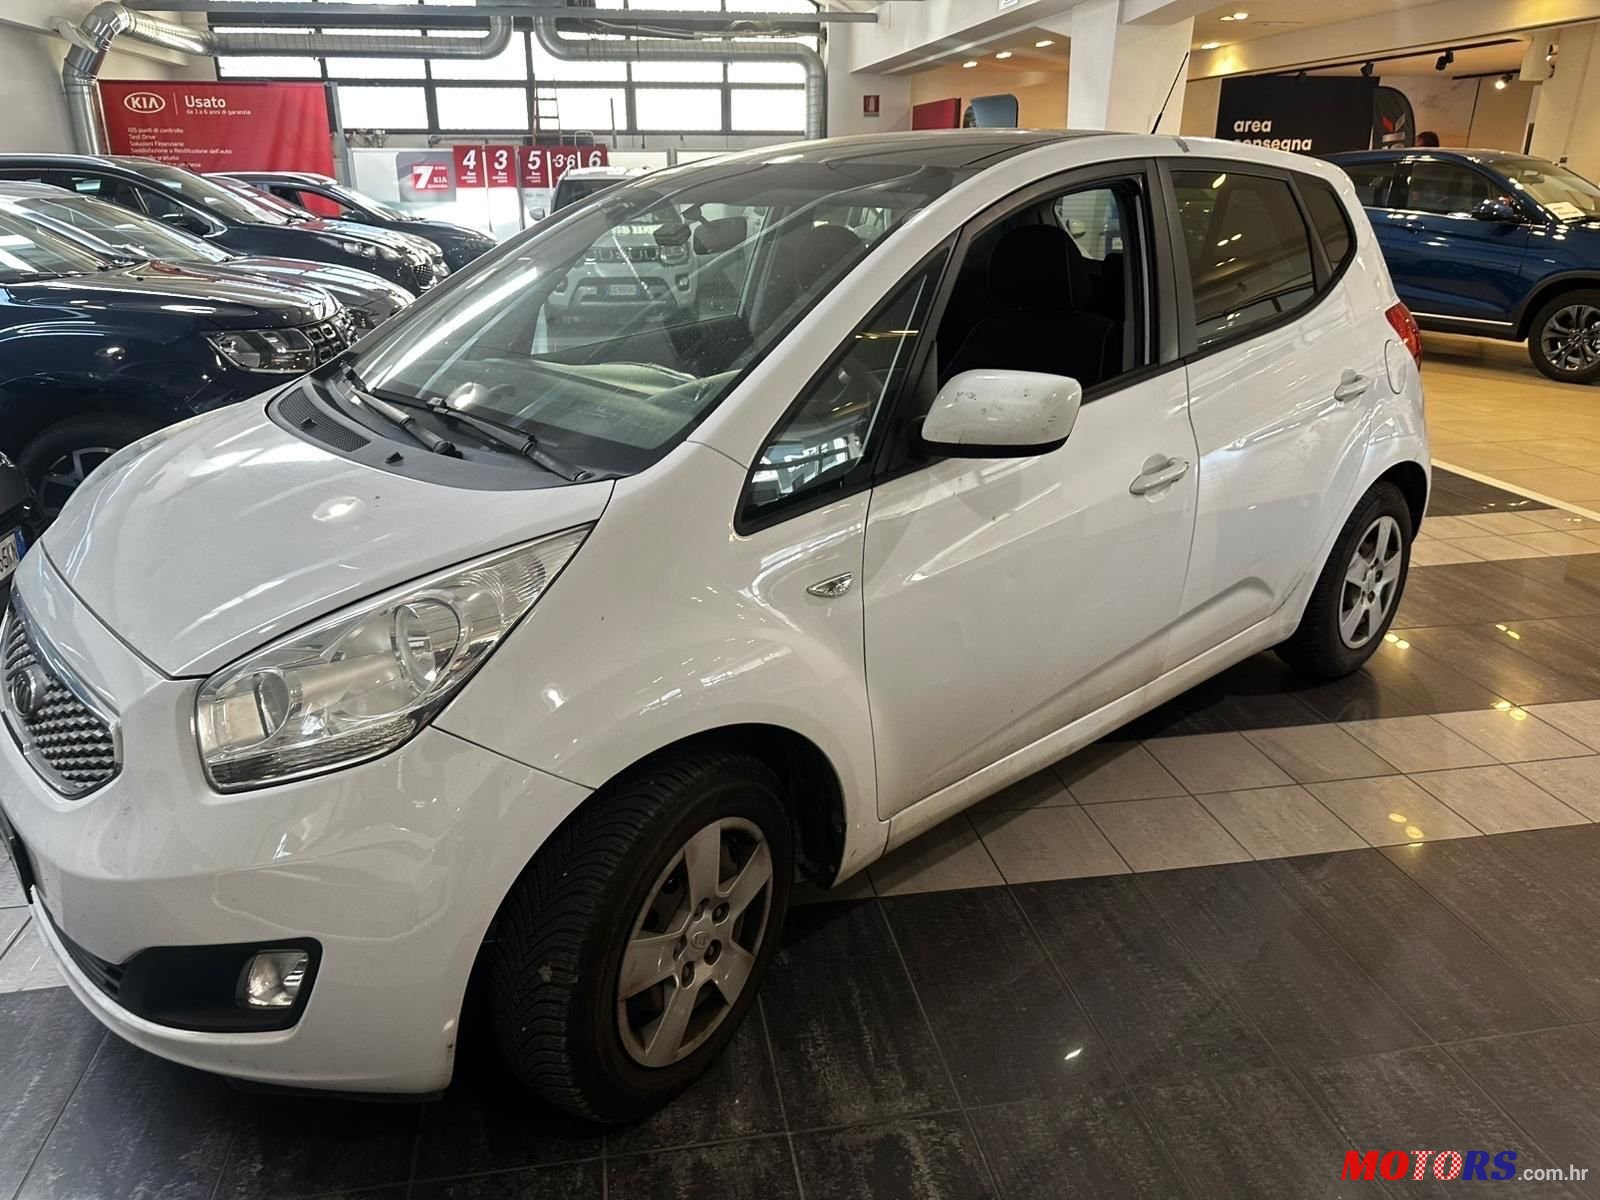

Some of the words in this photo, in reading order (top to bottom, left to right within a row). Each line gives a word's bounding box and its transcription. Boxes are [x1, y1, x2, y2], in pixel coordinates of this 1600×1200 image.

[131, 96, 159, 109] KIA
[184, 95, 226, 109] Usato
[1233, 120, 1272, 133] area
[462, 149, 477, 170] 4
[493, 149, 508, 170] 3
[527, 150, 542, 170] 5
[588, 150, 602, 168] 6
[412, 165, 434, 189] 7
